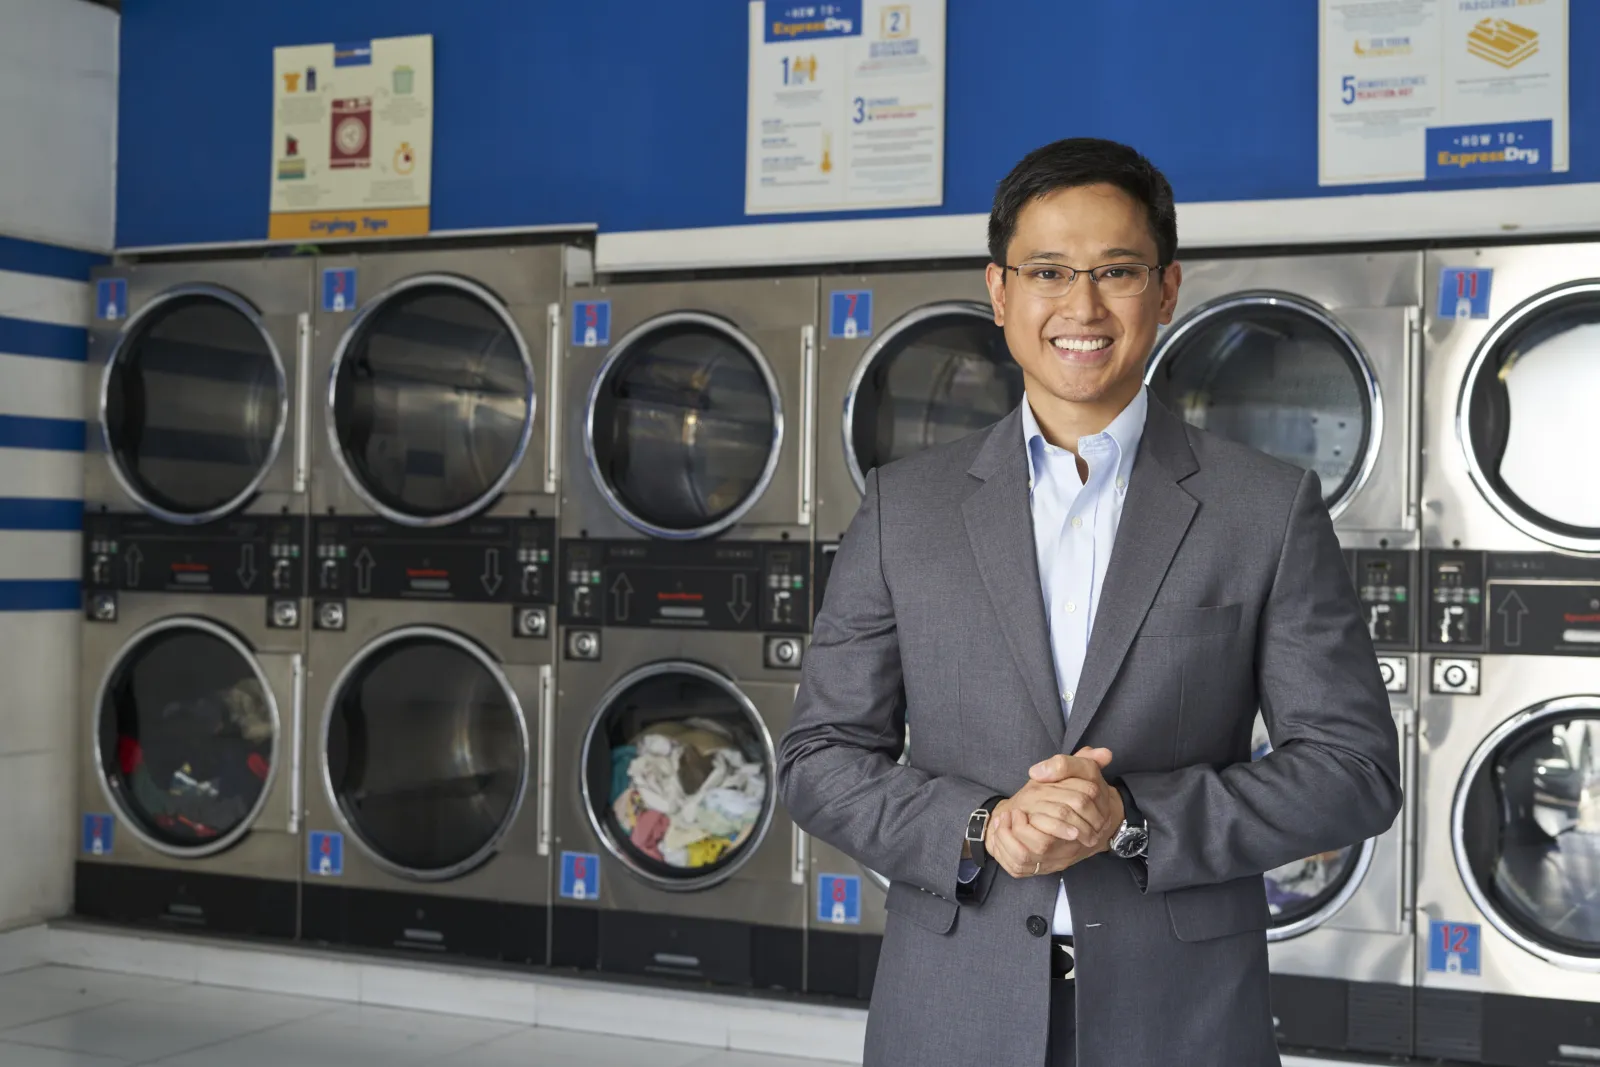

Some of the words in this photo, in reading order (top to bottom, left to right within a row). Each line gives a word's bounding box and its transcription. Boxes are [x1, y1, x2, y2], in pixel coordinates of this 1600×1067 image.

[890, 11, 901, 33] 2
[780, 56, 790, 86] 1
[1341, 75, 1355, 105] 5
[852, 96, 865, 125] 3
[1461, 135, 1492, 147] HOW
[1497, 132, 1516, 145] TO
[1437, 146, 1540, 168] ExpressDry
[1455, 272, 1478, 299] 11
[585, 304, 598, 328] 5
[845, 294, 858, 317] 7
[573, 857, 586, 880] 6
[832, 877, 847, 903] 8
[1441, 925, 1470, 953] 12
